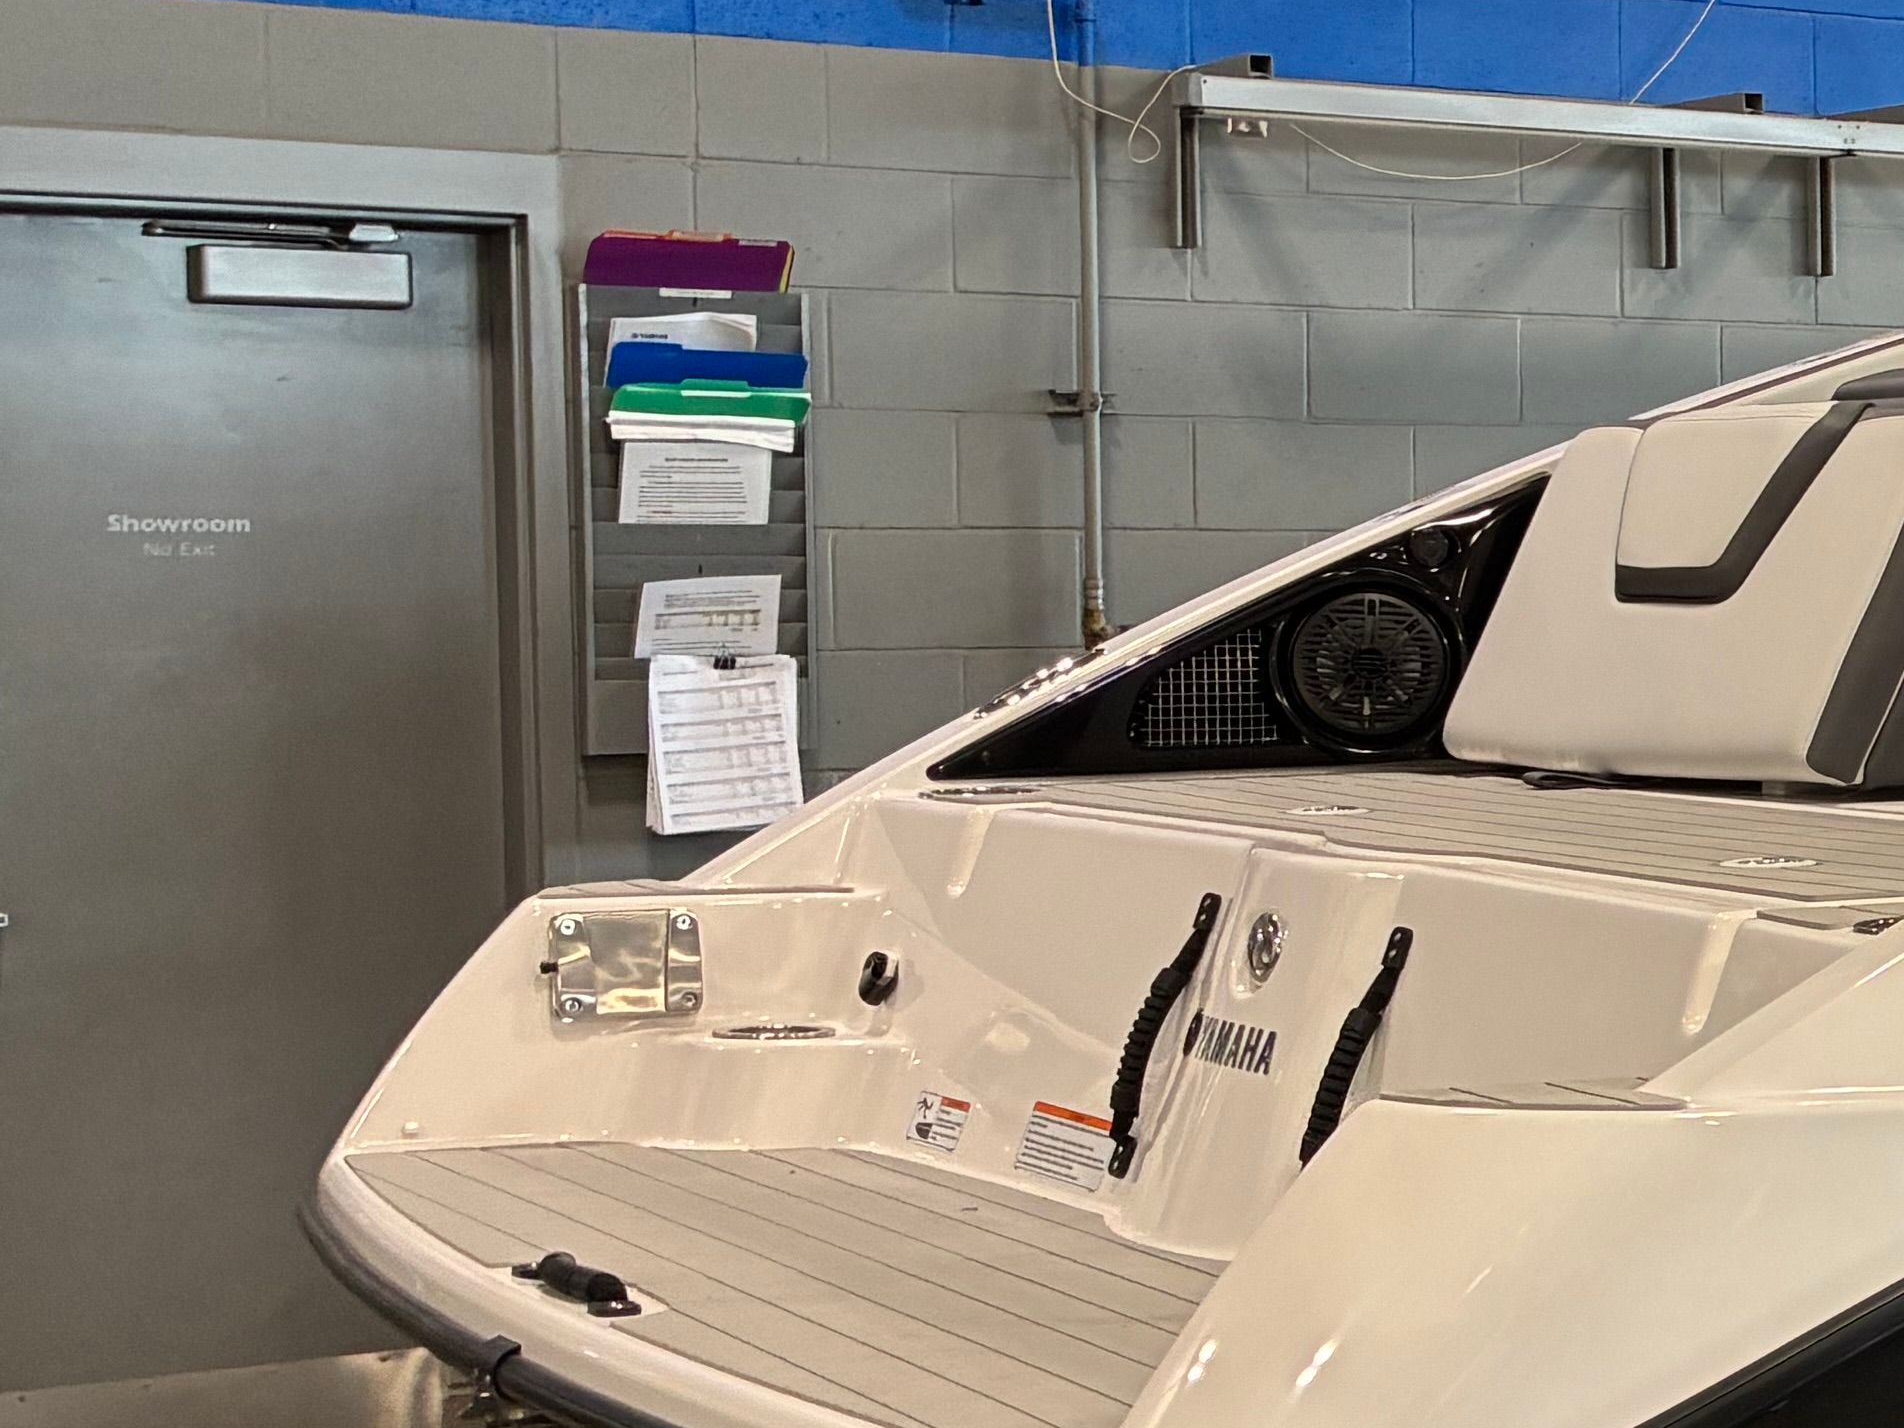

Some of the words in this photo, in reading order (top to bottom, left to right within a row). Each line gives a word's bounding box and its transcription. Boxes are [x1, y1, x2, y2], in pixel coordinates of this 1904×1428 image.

[106, 513, 251, 533] Showroom
[143, 542, 172, 557] No
[179, 541, 216, 557] Exit
[1194, 1015, 1277, 1076] YAMAHA
